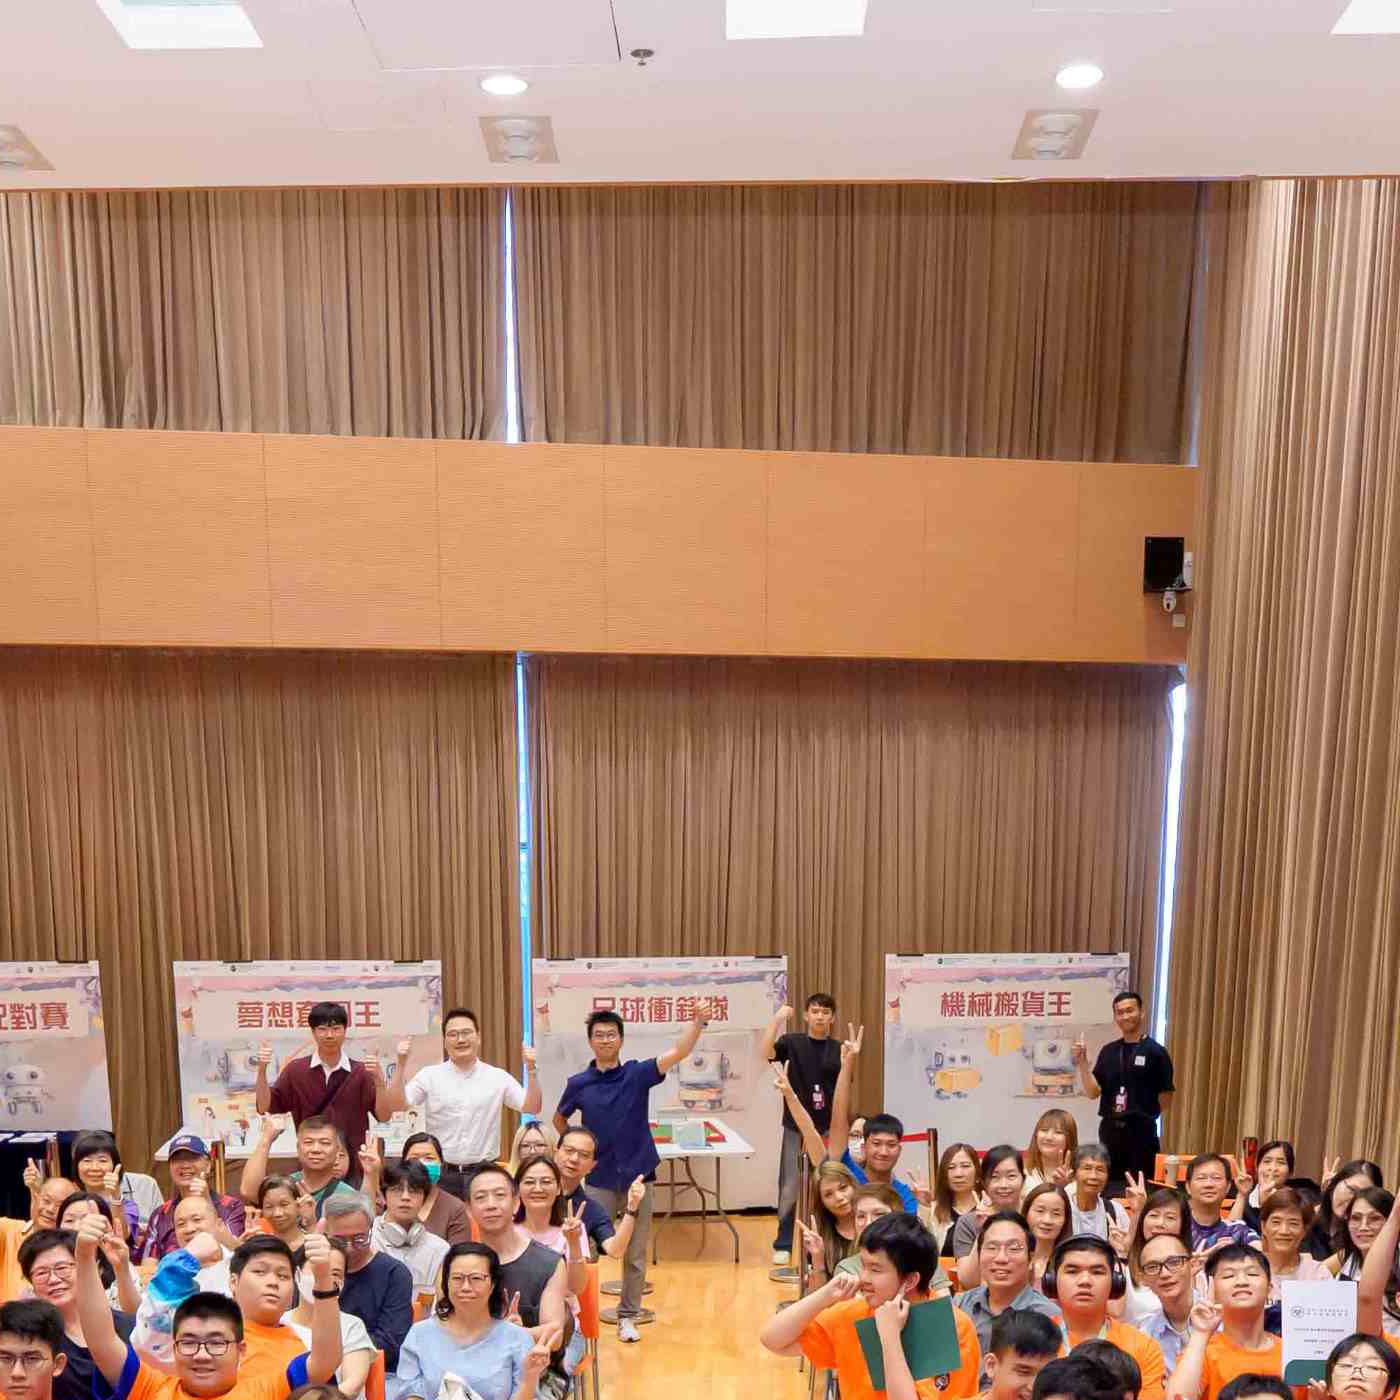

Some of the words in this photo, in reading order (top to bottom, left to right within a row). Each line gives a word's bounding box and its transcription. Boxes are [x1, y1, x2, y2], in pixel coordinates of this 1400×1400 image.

[940, 991, 1072, 1017] 機械搬貨王
